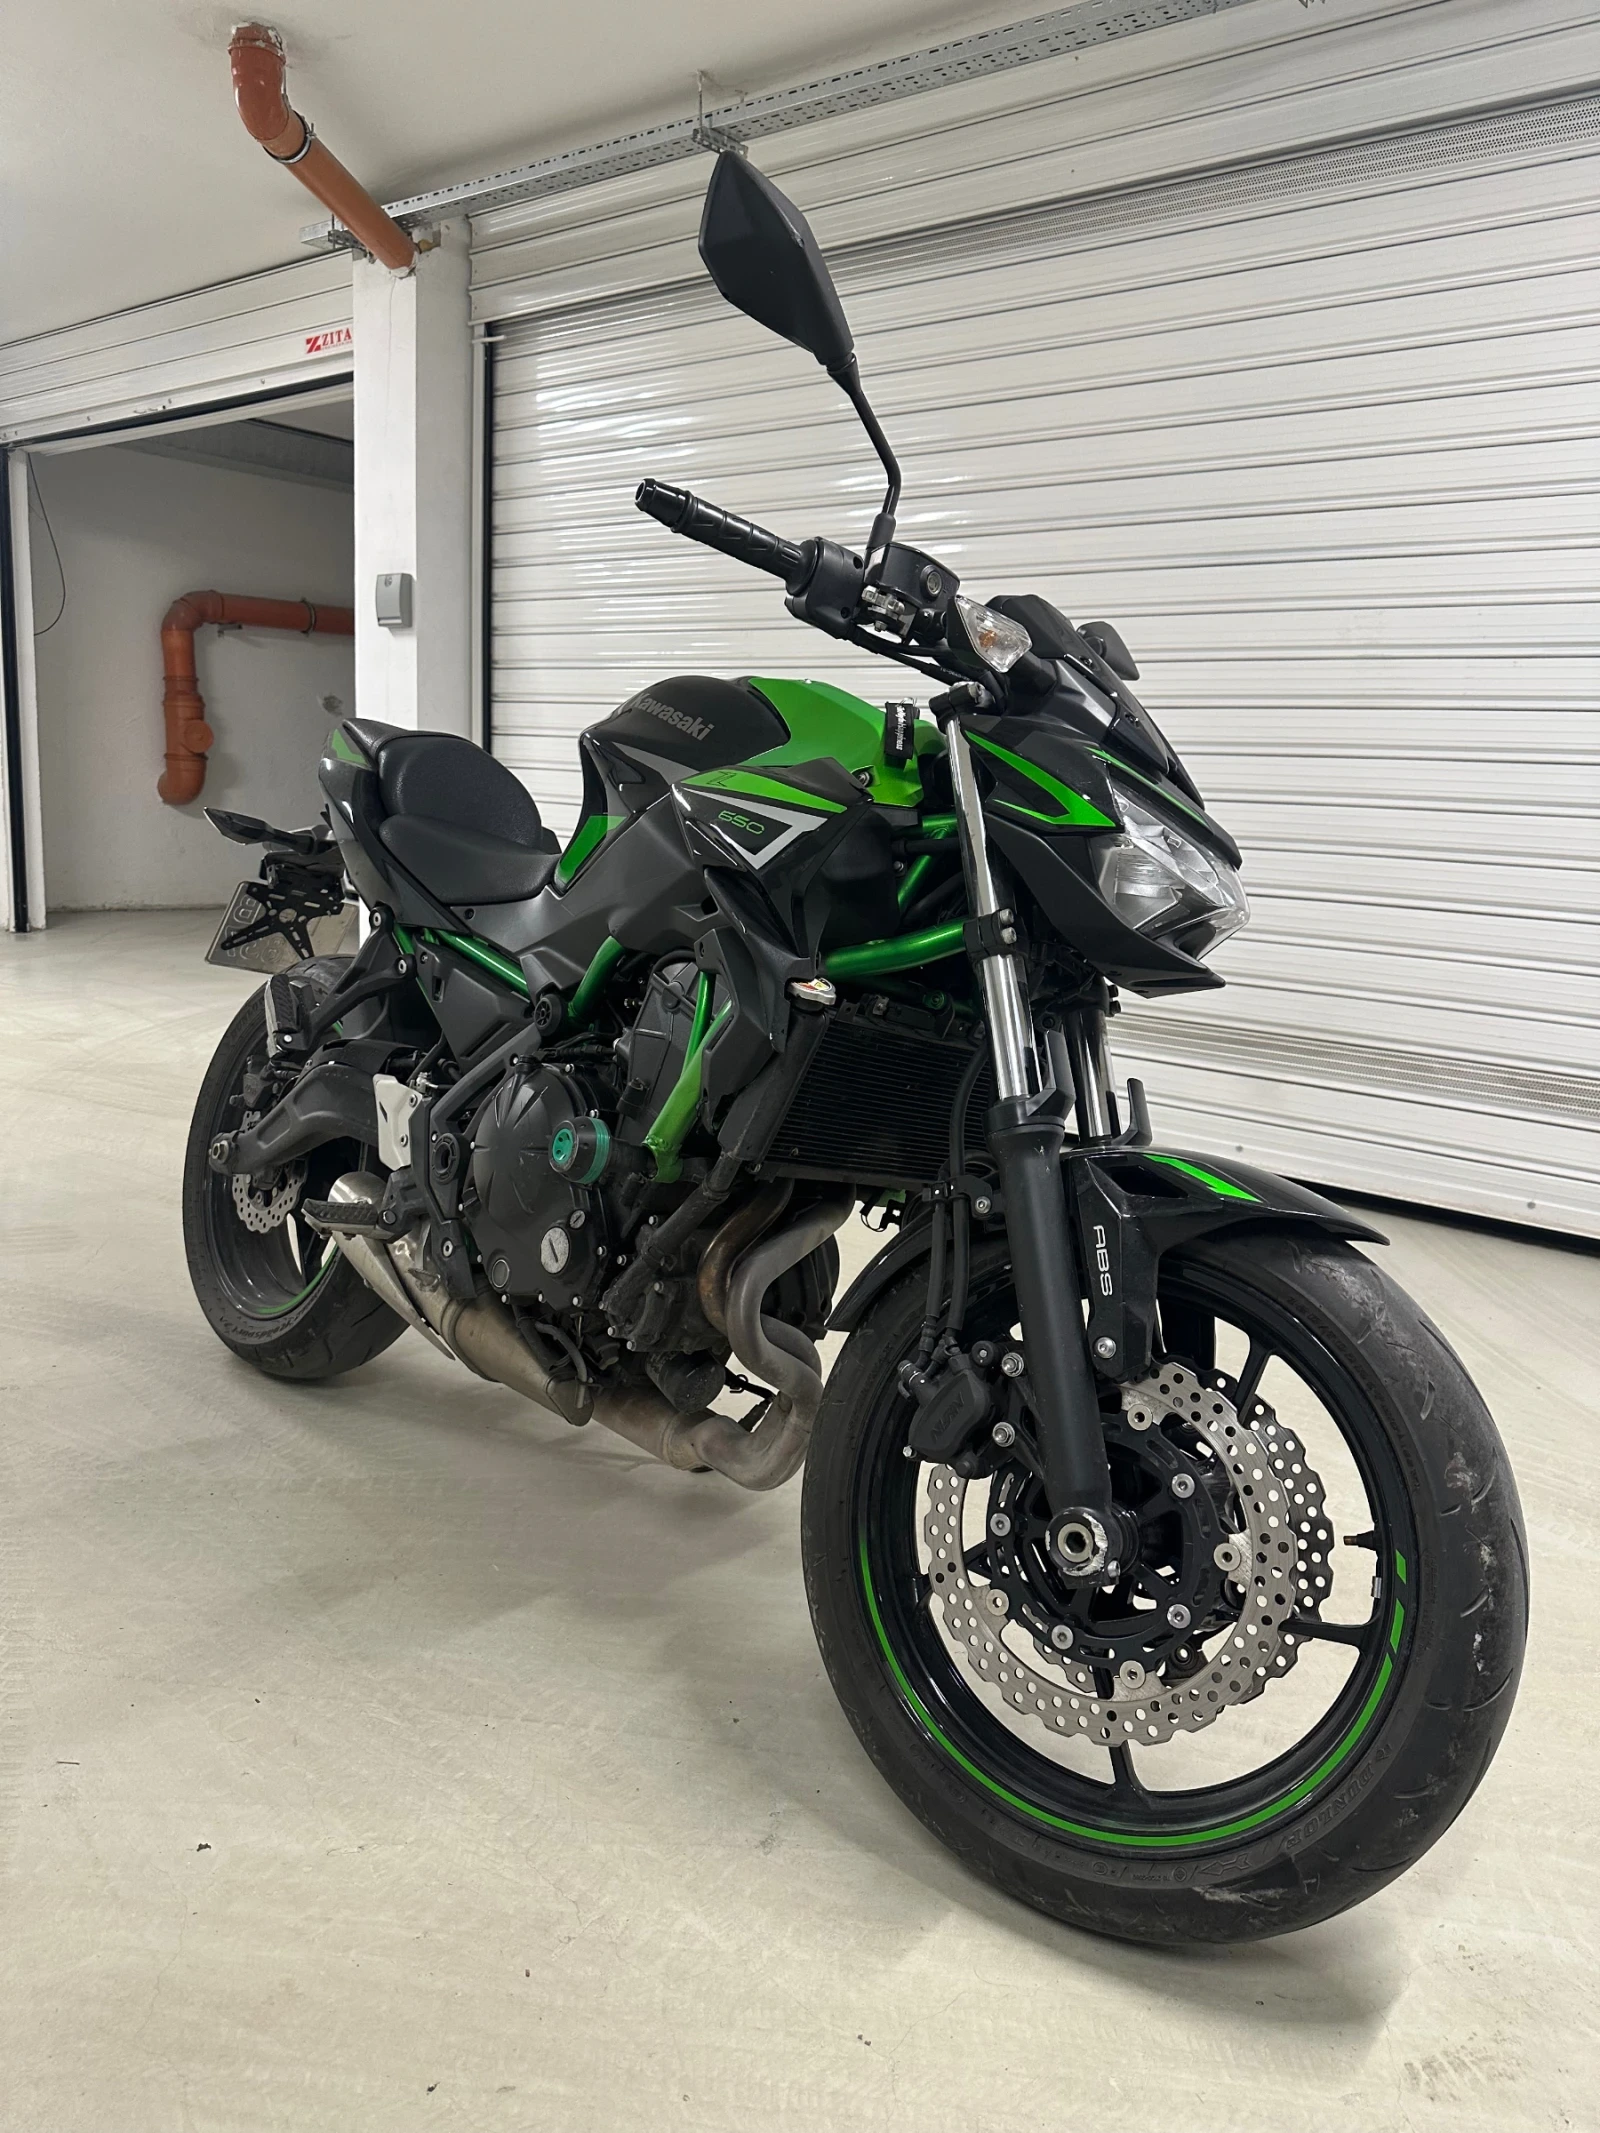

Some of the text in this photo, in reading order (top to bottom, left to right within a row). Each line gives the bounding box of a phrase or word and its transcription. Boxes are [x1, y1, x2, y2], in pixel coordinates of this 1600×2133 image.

[322, 327, 352, 346] ZITA
[629, 692, 715, 741] Kawasaki
[718, 810, 765, 835] 650
[1093, 1225, 1113, 1296] ABS
